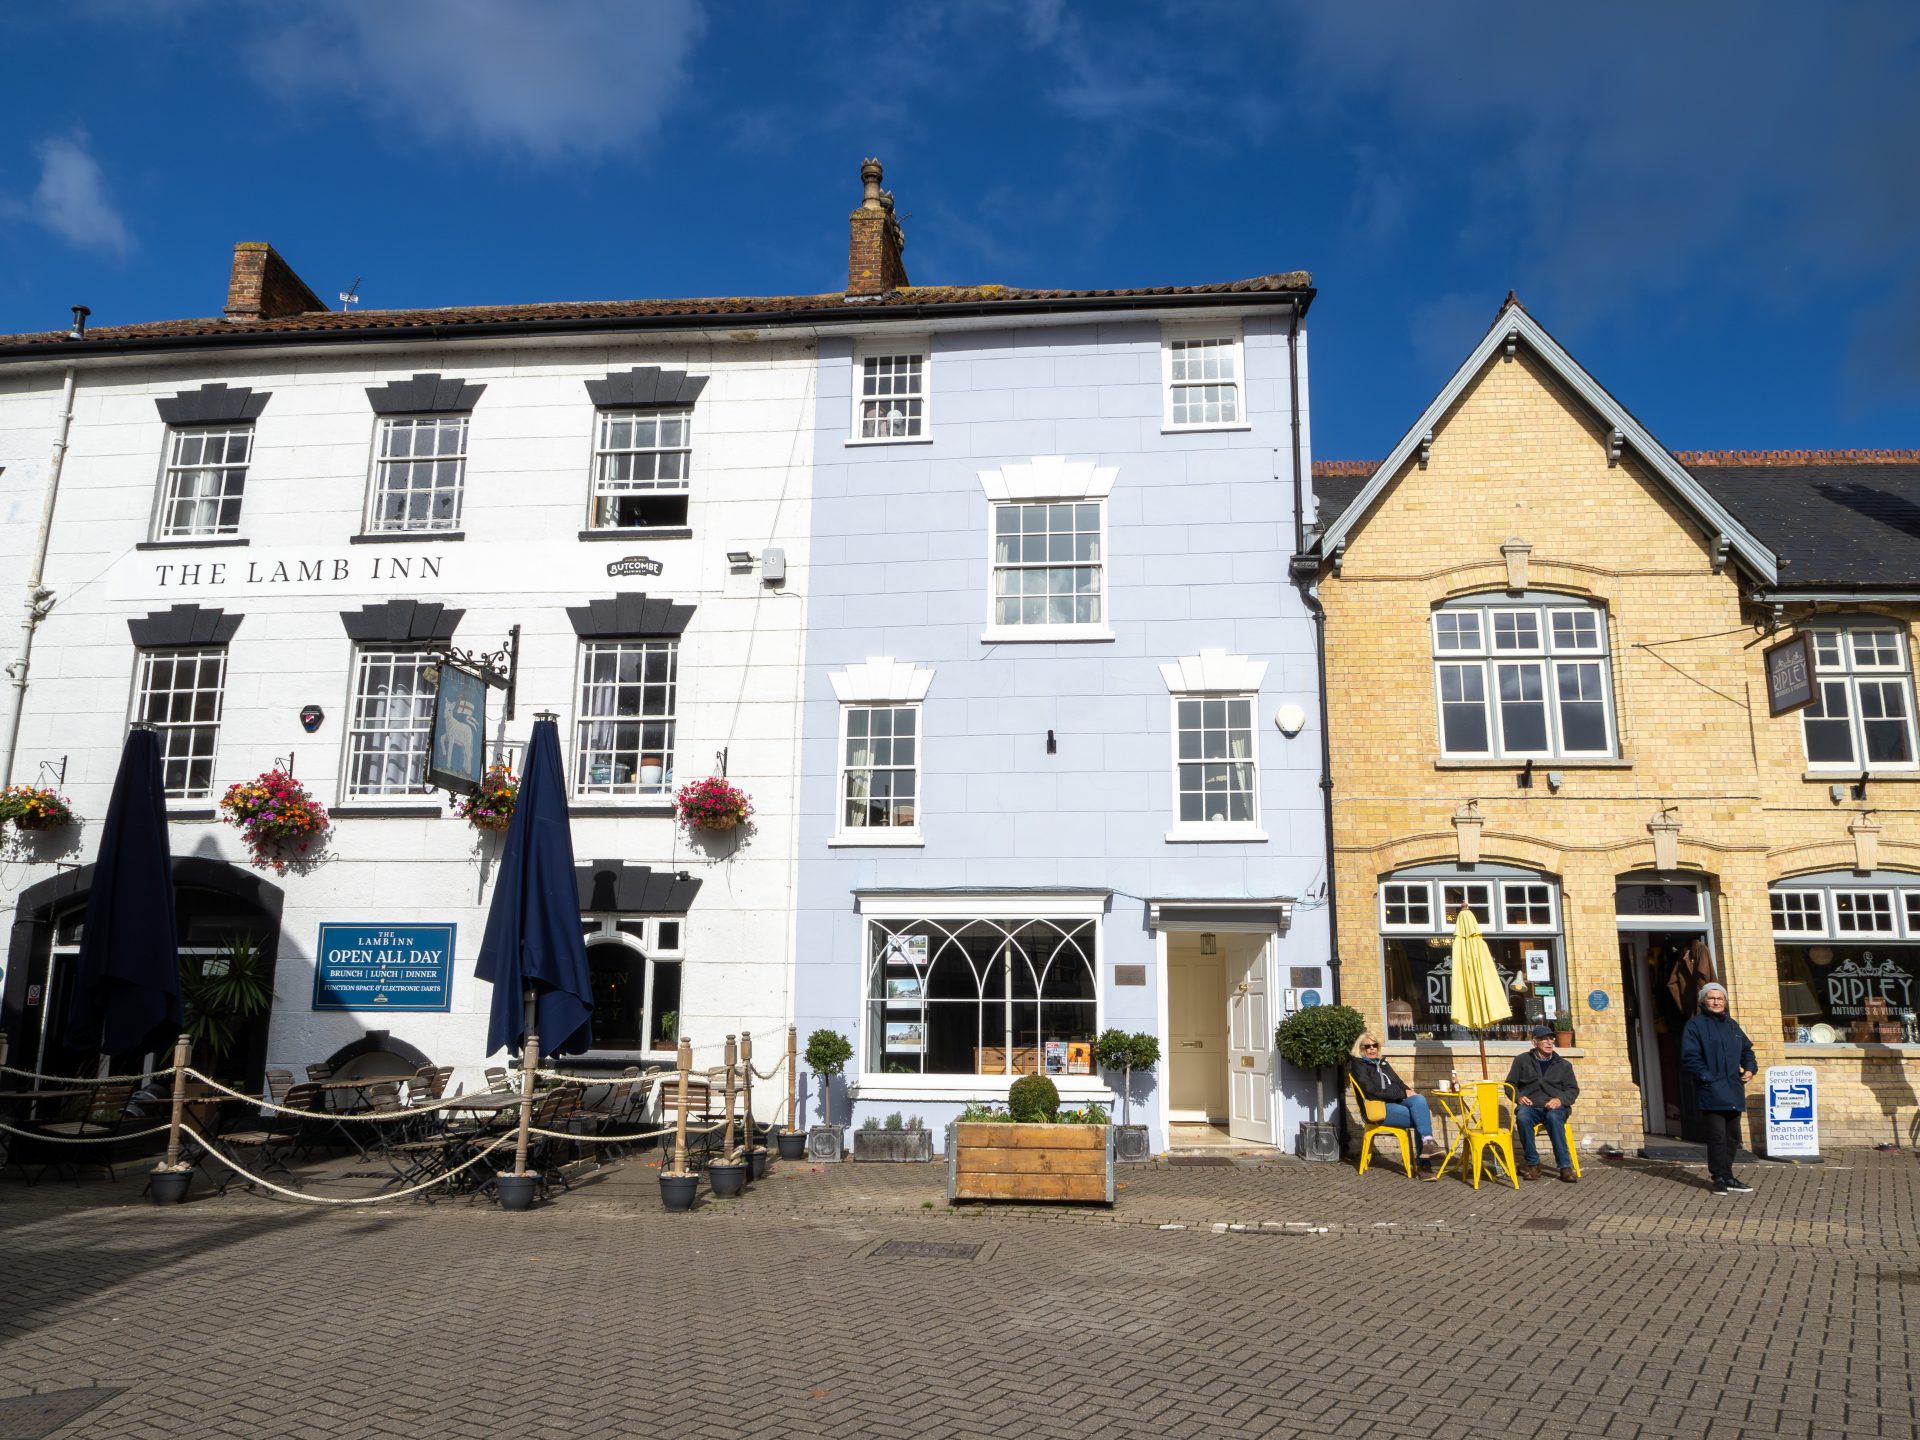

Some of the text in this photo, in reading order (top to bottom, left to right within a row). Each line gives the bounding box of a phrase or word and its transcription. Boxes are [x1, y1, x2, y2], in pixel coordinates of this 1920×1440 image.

[156, 556, 443, 586] THE LAMB INN
[609, 562, 659, 575] BUTCOMBE
[1772, 661, 1807, 691] RIPLEY
[358, 938, 414, 946] LAMB INN
[328, 949, 442, 964] OPEN ALL DAY
[330, 970, 437, 978] BRUNCH LUNCH DINNER
[1426, 975, 1514, 1004] RIY
[1827, 978, 1913, 1005] RIPLEY
[1831, 1006, 1913, 1016] ANTIQUES & VINTAGE
[1403, 1023, 1441, 1032] CLEARANCE
[1790, 1069, 1813, 1077] Coffee
[1770, 1125, 1814, 1133] beans and
[1771, 1133, 1814, 1141] machines
